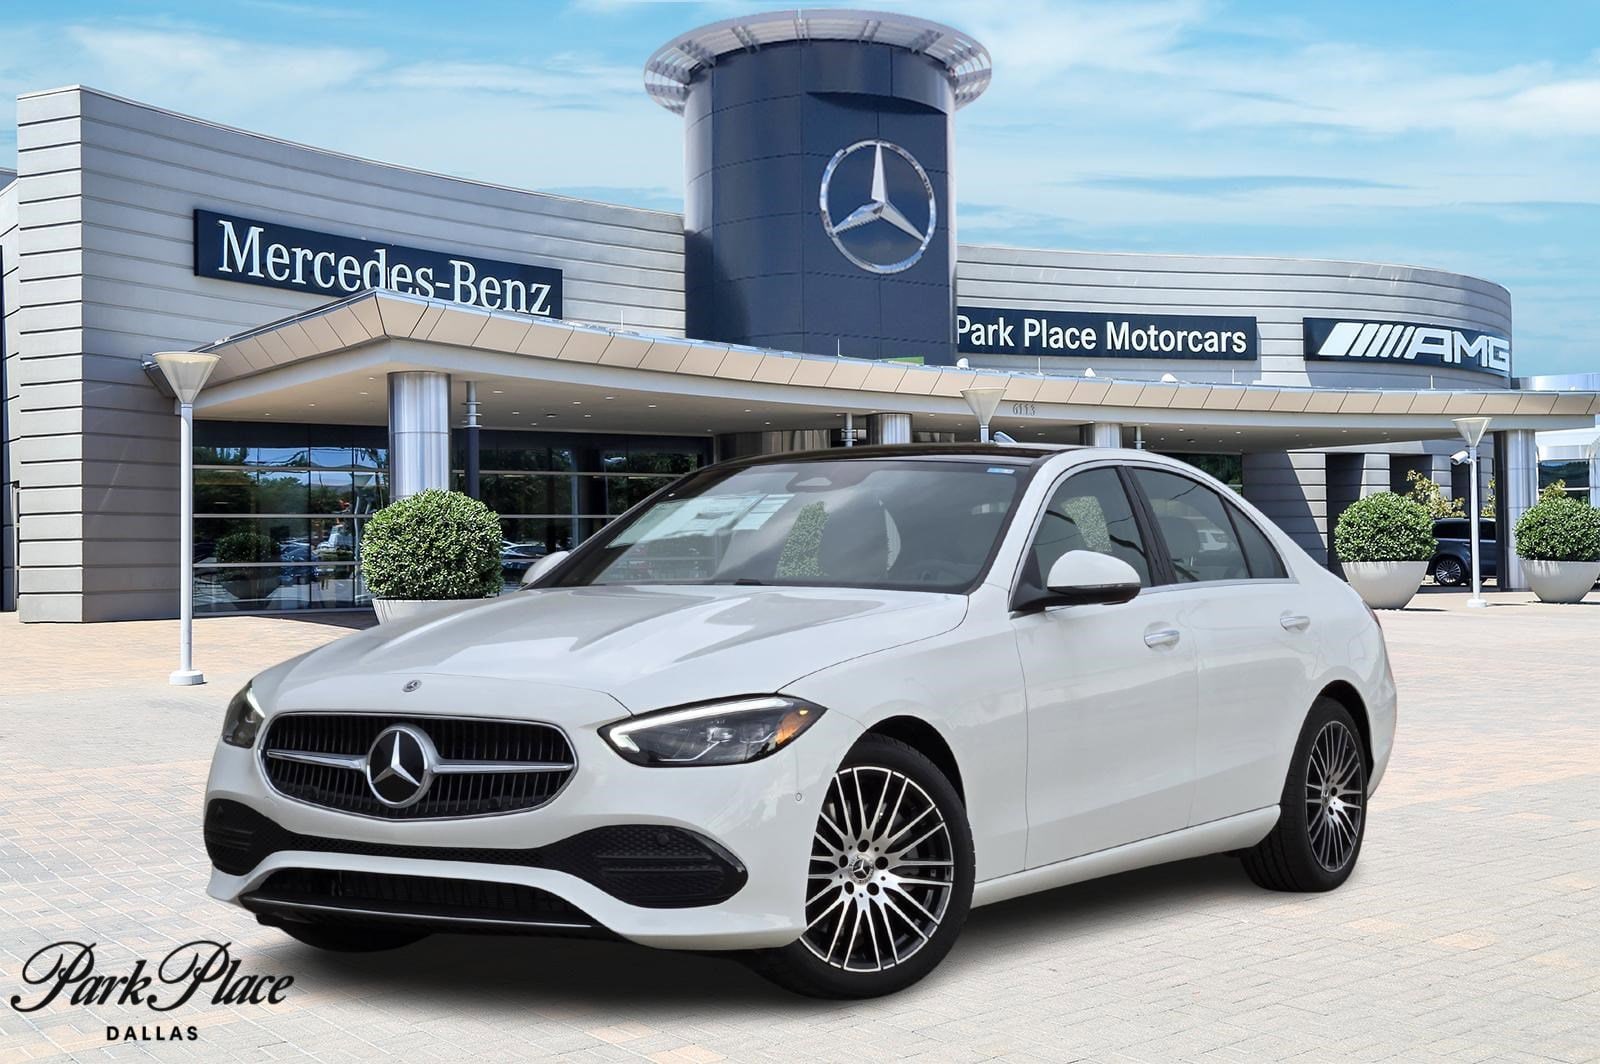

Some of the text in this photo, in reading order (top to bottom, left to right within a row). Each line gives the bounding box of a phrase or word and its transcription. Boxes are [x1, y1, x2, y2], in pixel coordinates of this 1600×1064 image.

[217, 219, 552, 316] Mercedes-Benz
[956, 314, 1248, 353] Park Place Motorcars
[1403, 326, 1510, 372] AMG
[1012, 402, 1036, 417] 6113
